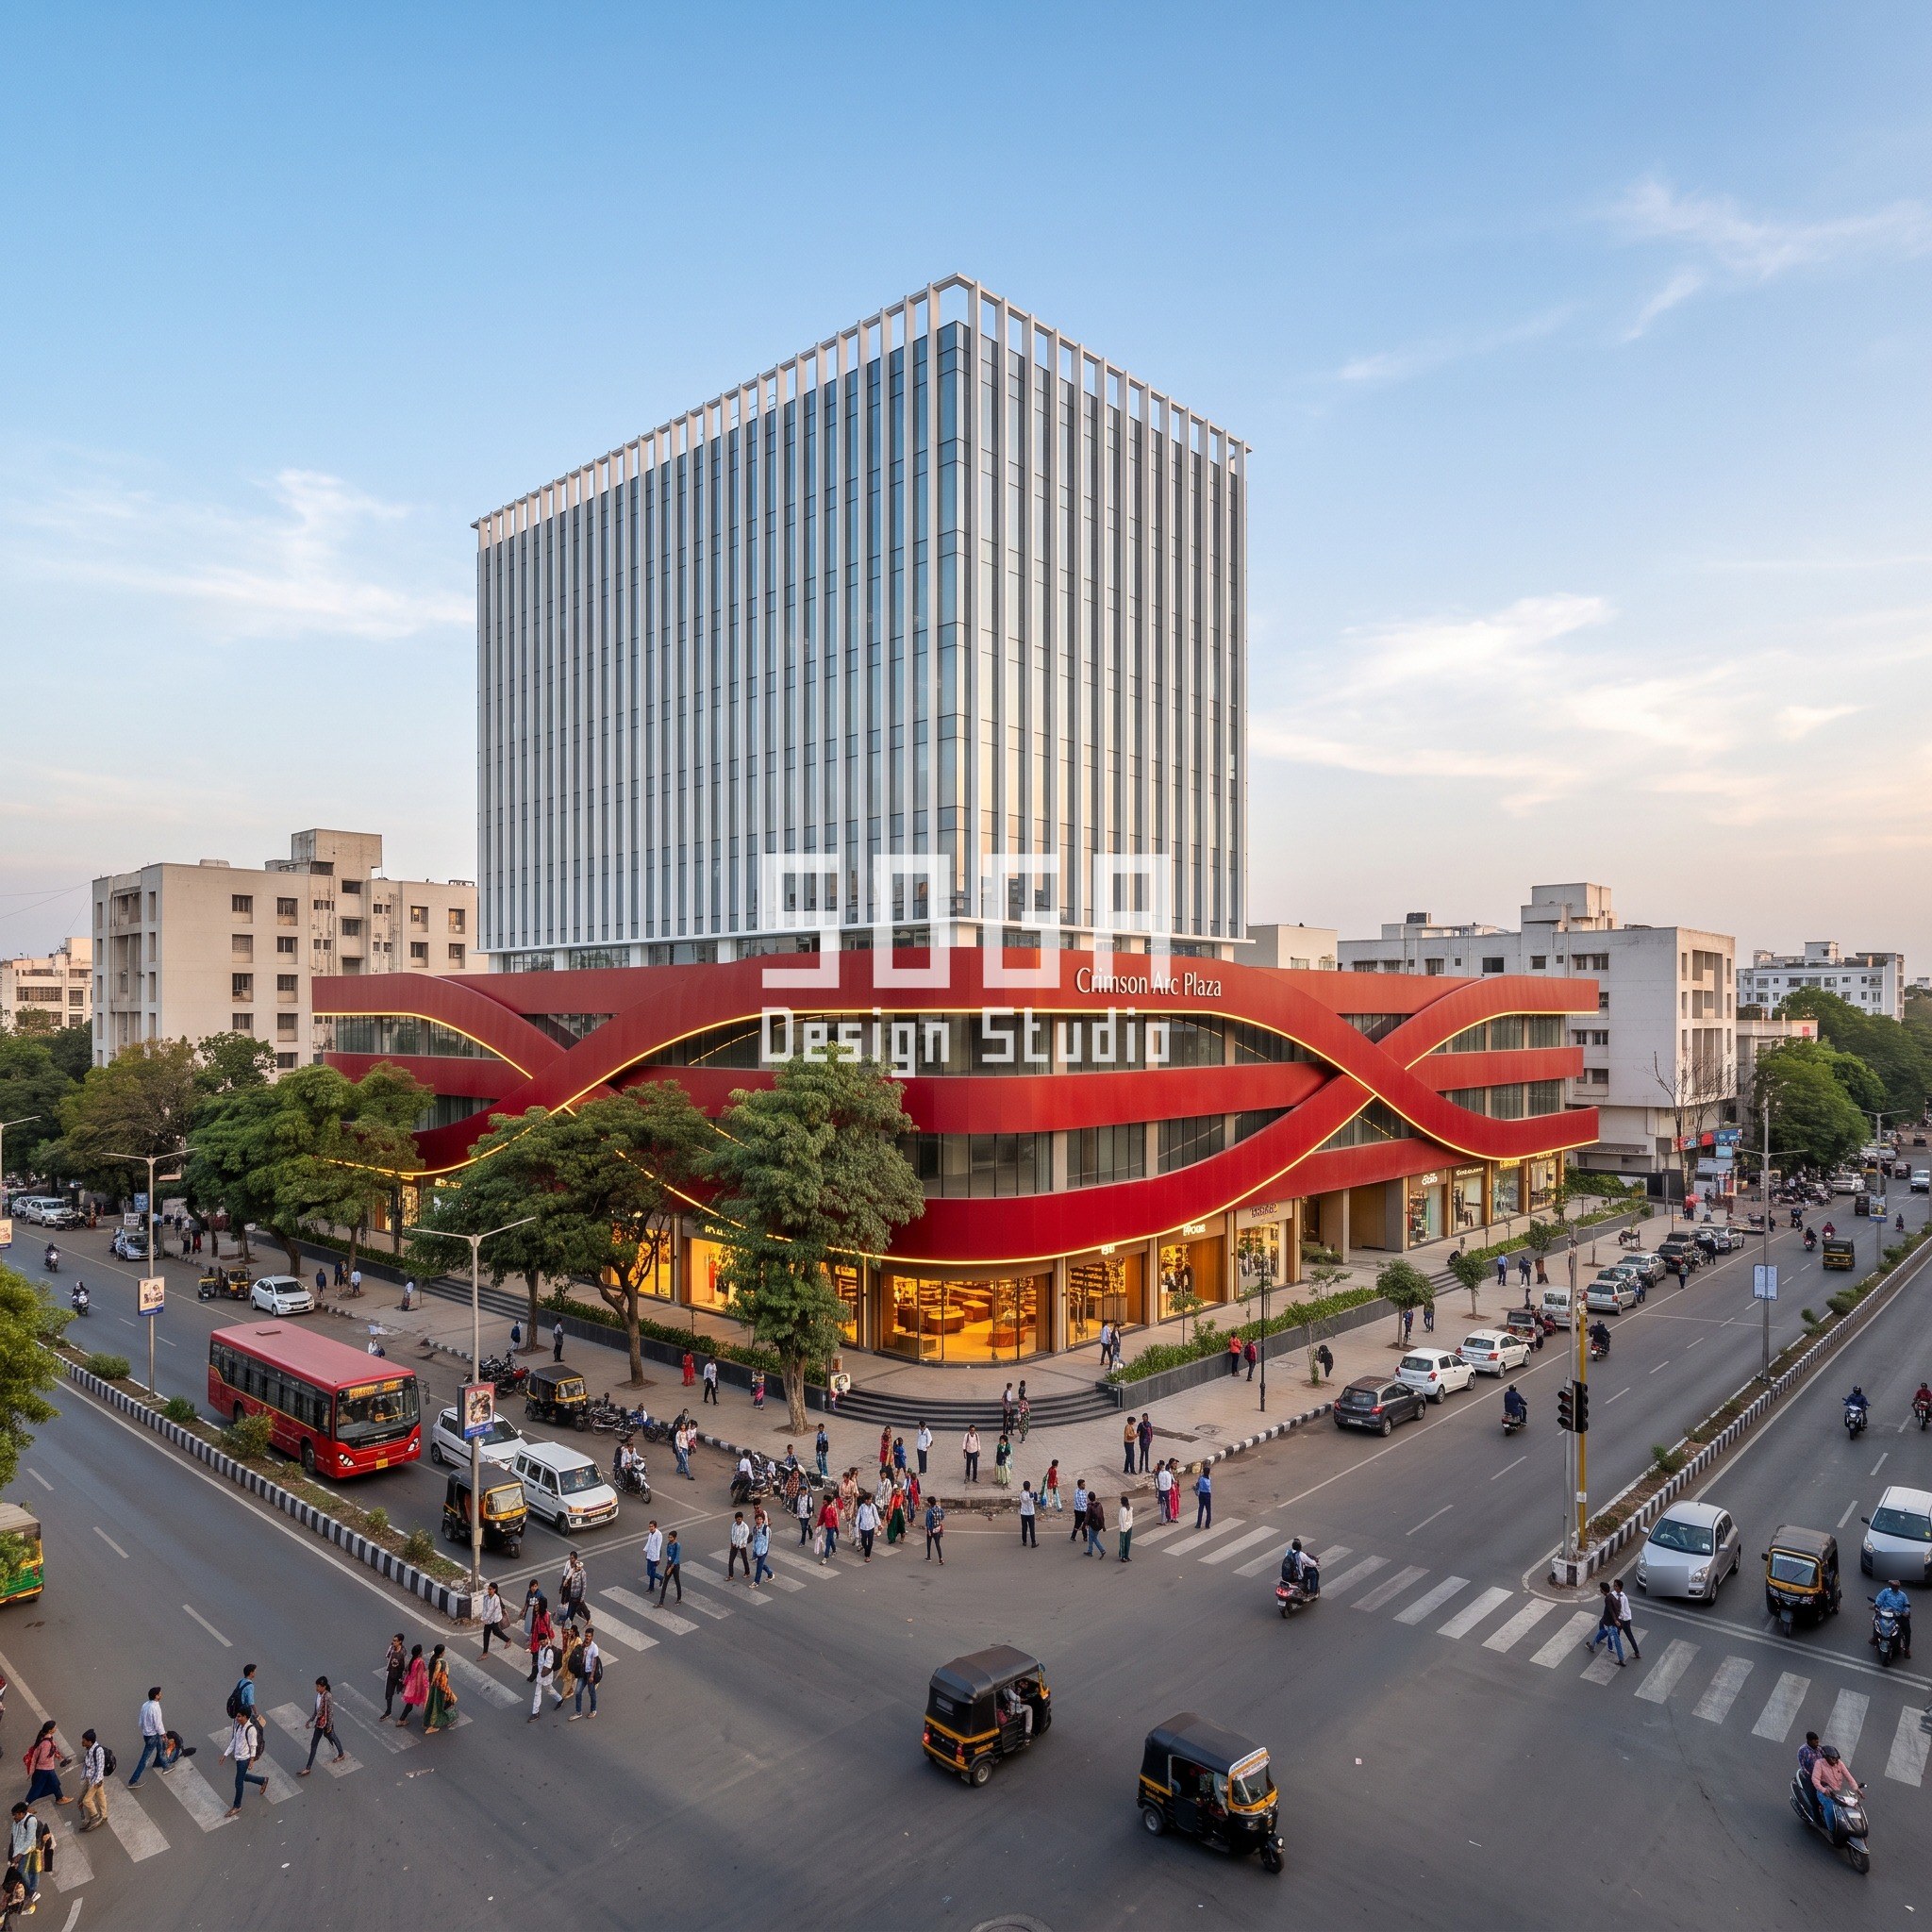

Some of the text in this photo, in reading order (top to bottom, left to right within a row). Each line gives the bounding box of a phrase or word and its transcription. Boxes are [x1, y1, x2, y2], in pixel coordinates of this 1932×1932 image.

[1076, 967, 1223, 996] Crimson Arc Plaza
